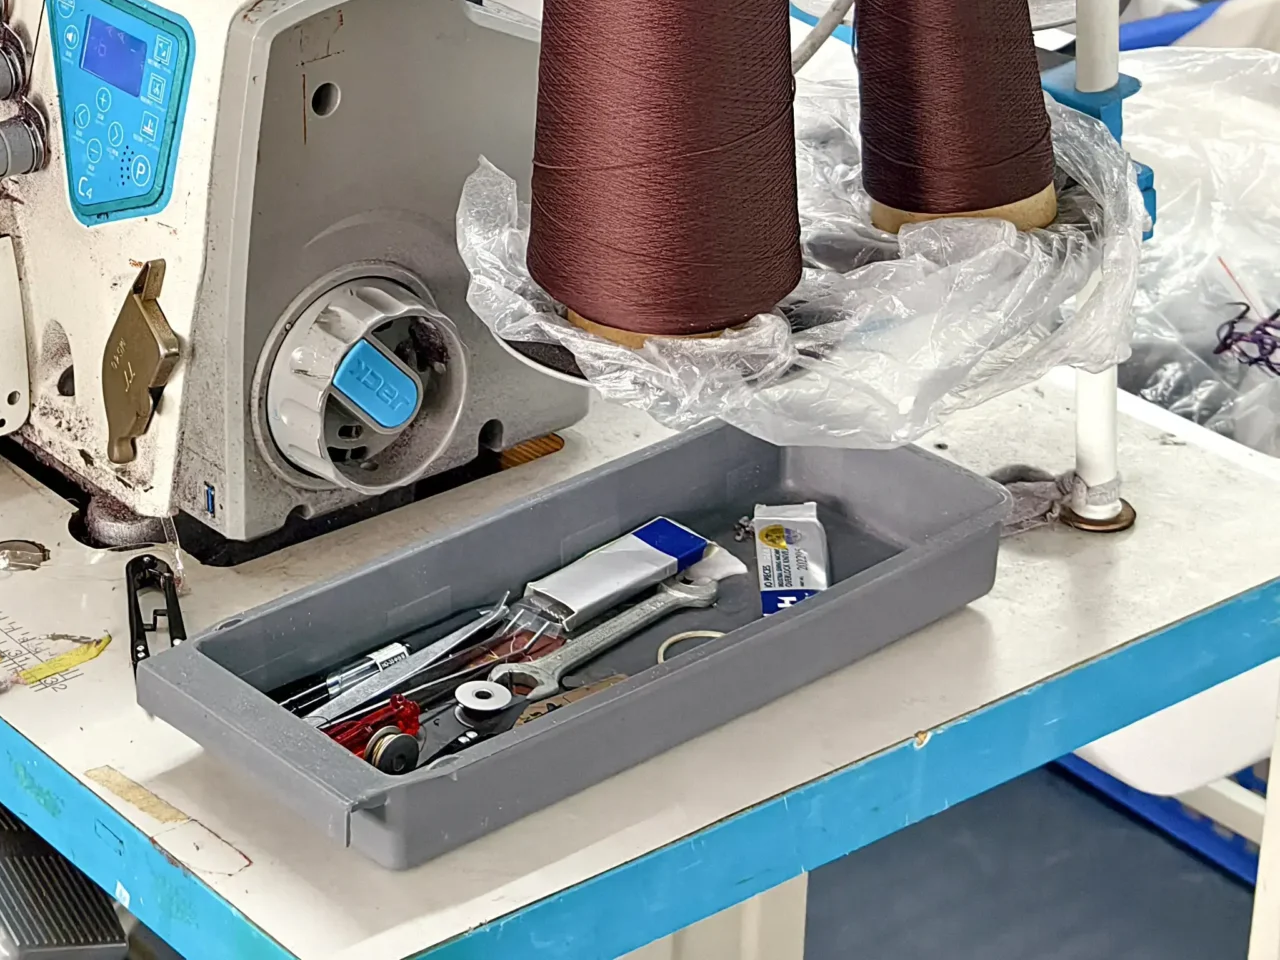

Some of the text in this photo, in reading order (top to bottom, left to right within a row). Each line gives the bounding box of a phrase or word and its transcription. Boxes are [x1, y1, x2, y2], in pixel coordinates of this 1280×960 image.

[762, 565, 772, 581] PIECES
[7, 649, 28, 664] 31
[43, 677, 67, 692] 32
